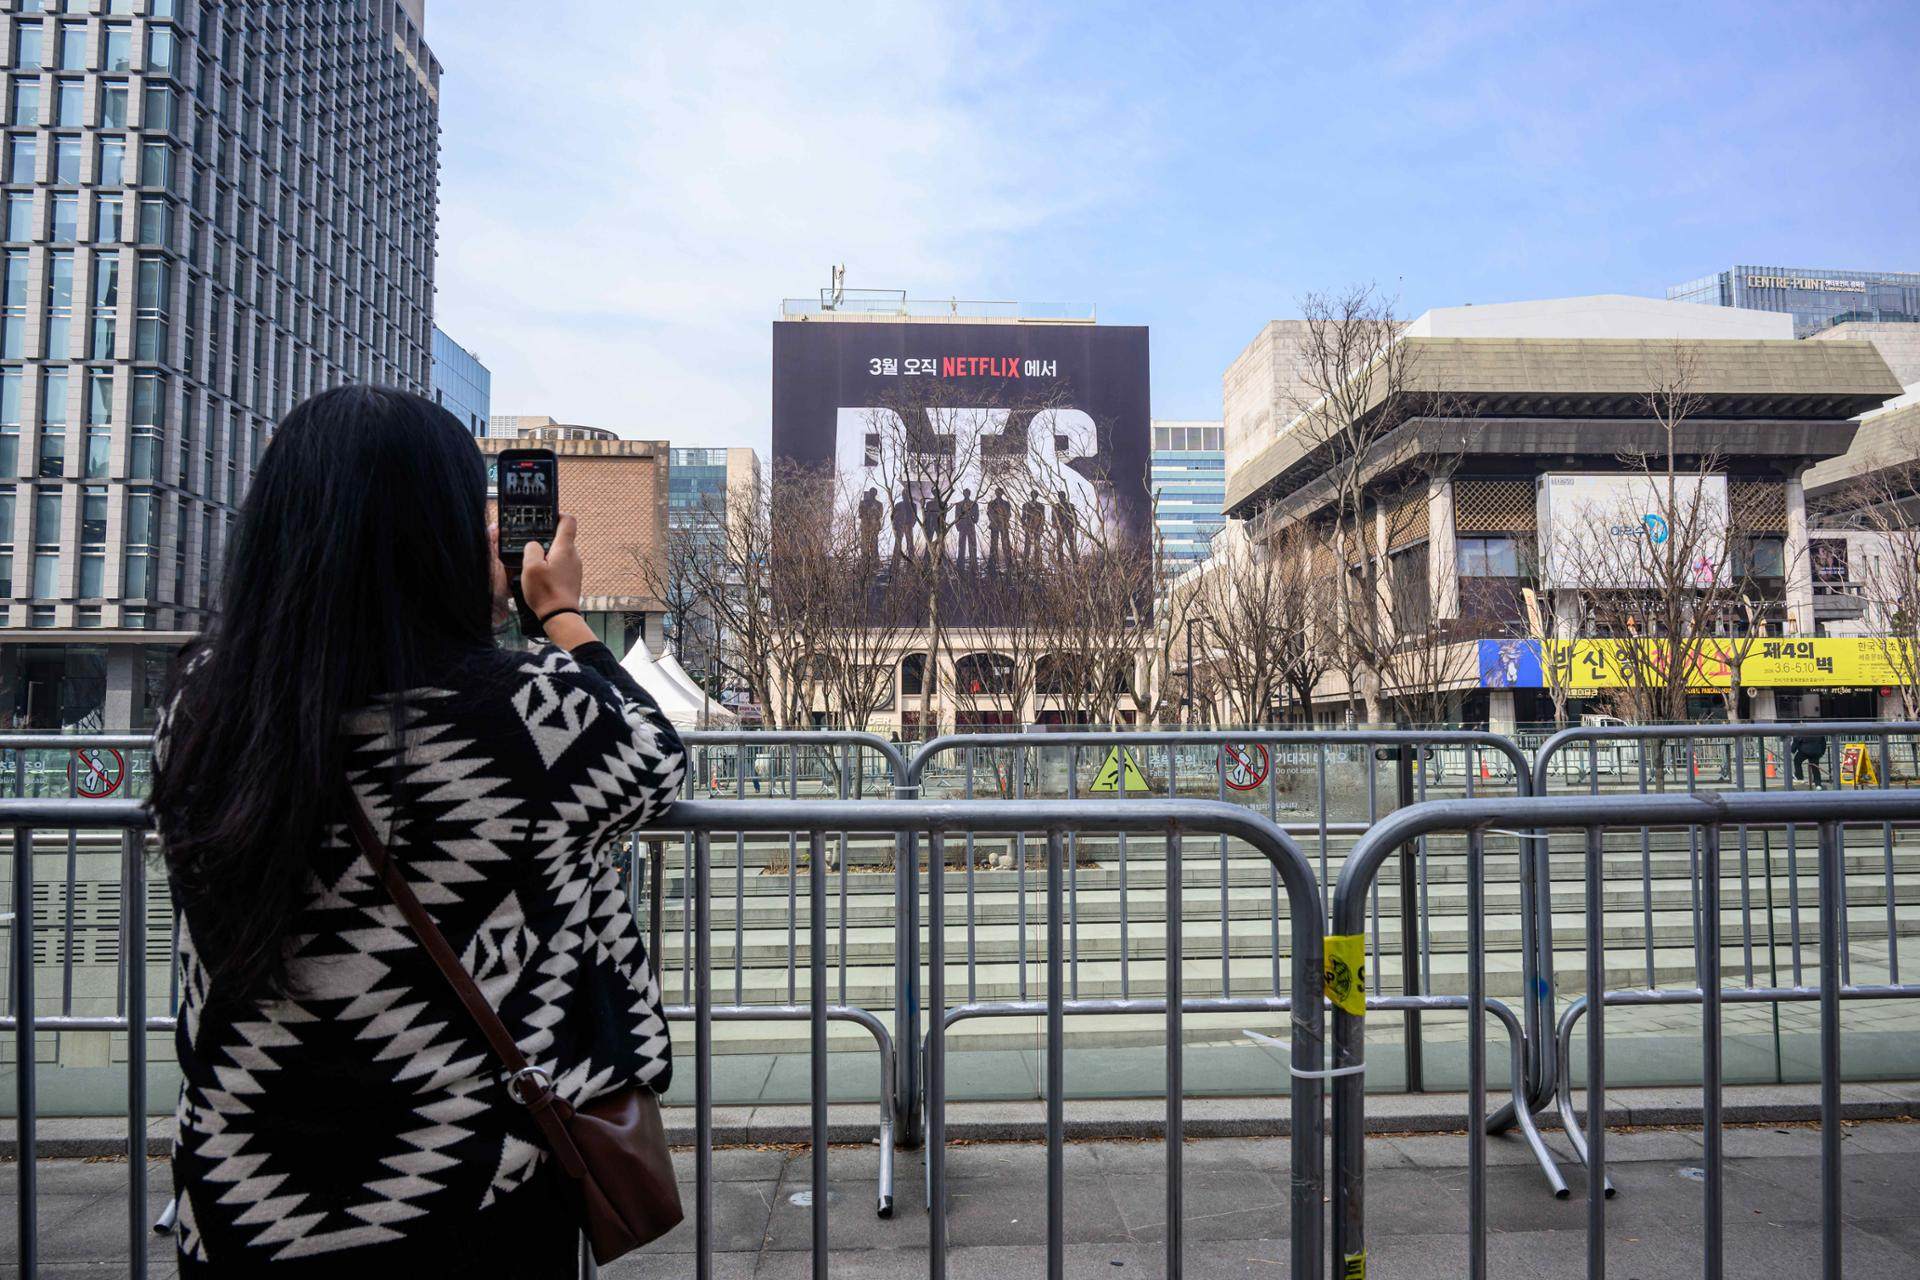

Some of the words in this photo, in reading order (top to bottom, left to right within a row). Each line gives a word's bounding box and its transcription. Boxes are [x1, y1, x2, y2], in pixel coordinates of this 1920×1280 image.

[869, 358, 898, 375] 3월
[904, 358, 936, 376] 오직
[943, 357, 1020, 378] NETFLIX
[1024, 360, 1057, 377] 에서
[834, 406, 1098, 556] BTS
[1763, 642, 1814, 659] 제4의
[1816, 657, 1834, 674] 벽
